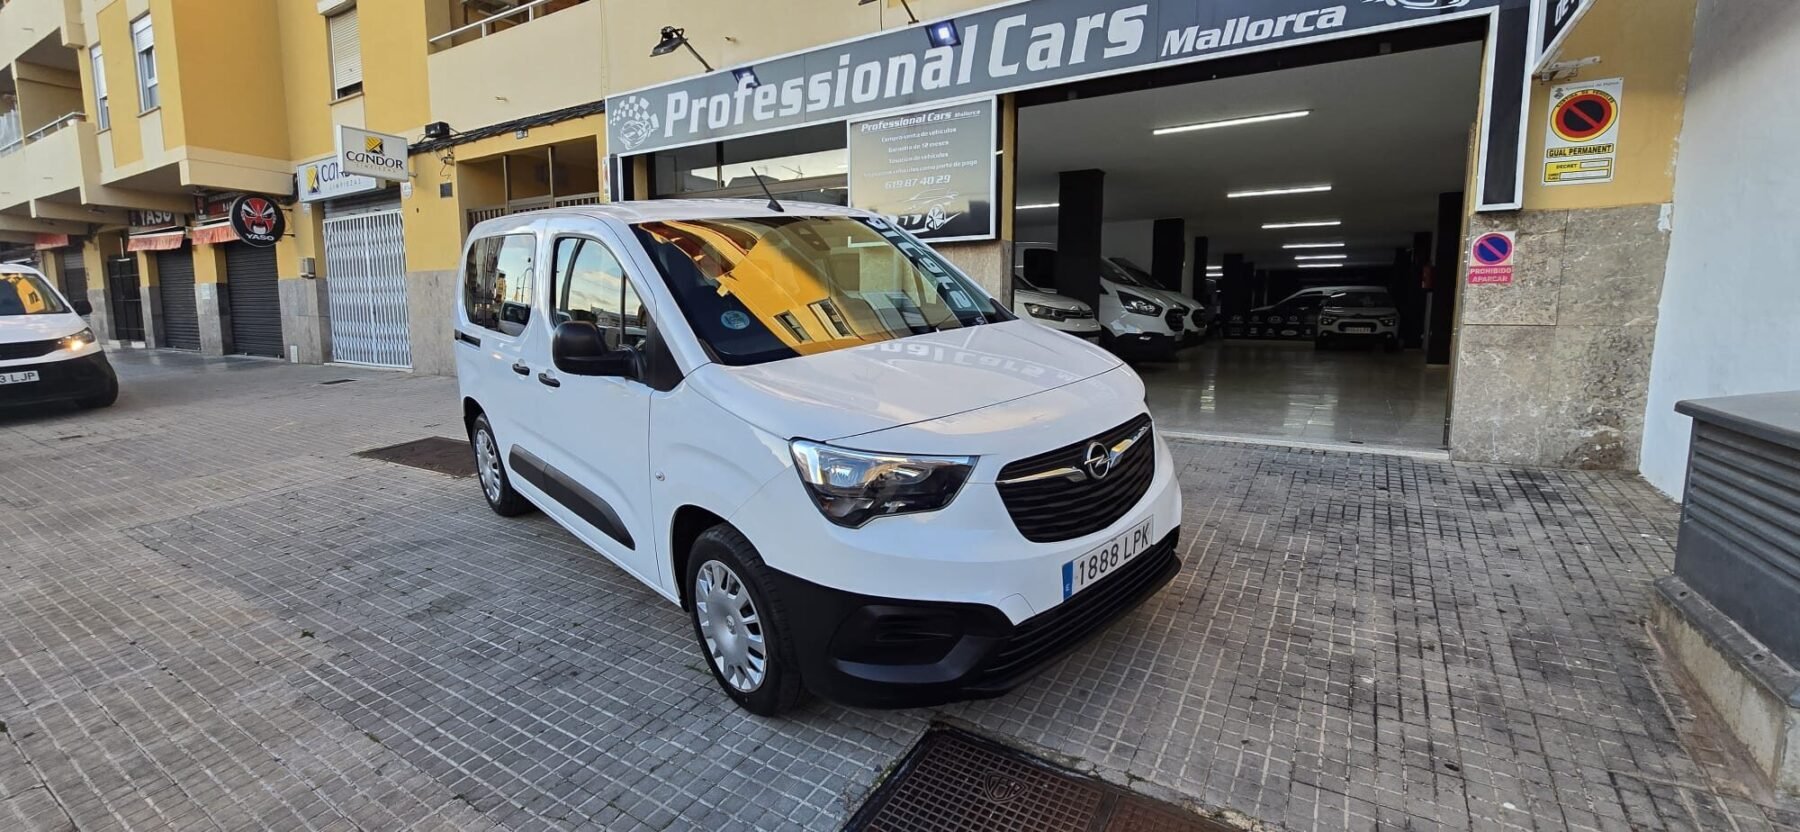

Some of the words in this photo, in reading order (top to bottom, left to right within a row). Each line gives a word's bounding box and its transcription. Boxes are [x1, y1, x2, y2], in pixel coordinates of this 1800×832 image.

[663, 24, 979, 138] Professional
[987, 3, 1149, 78] Cars
[1160, 4, 1348, 57] Mallorca
[861, 114, 926, 132] Professional
[927, 111, 952, 122] Cars
[1549, 148, 1567, 157] GUAL
[1568, 144, 1611, 156] PERMANENT
[904, 178, 919, 188] 87
[919, 175, 935, 186] 40
[935, 174, 952, 184] 29
[246, 233, 275, 241] YASO
[1470, 267, 1512, 275] PROHIBIDO
[1471, 275, 1509, 283] APARCAR
[10, 372, 36, 383] LJP
[1079, 543, 1119, 585] 1888
[1123, 522, 1150, 560] LPK
